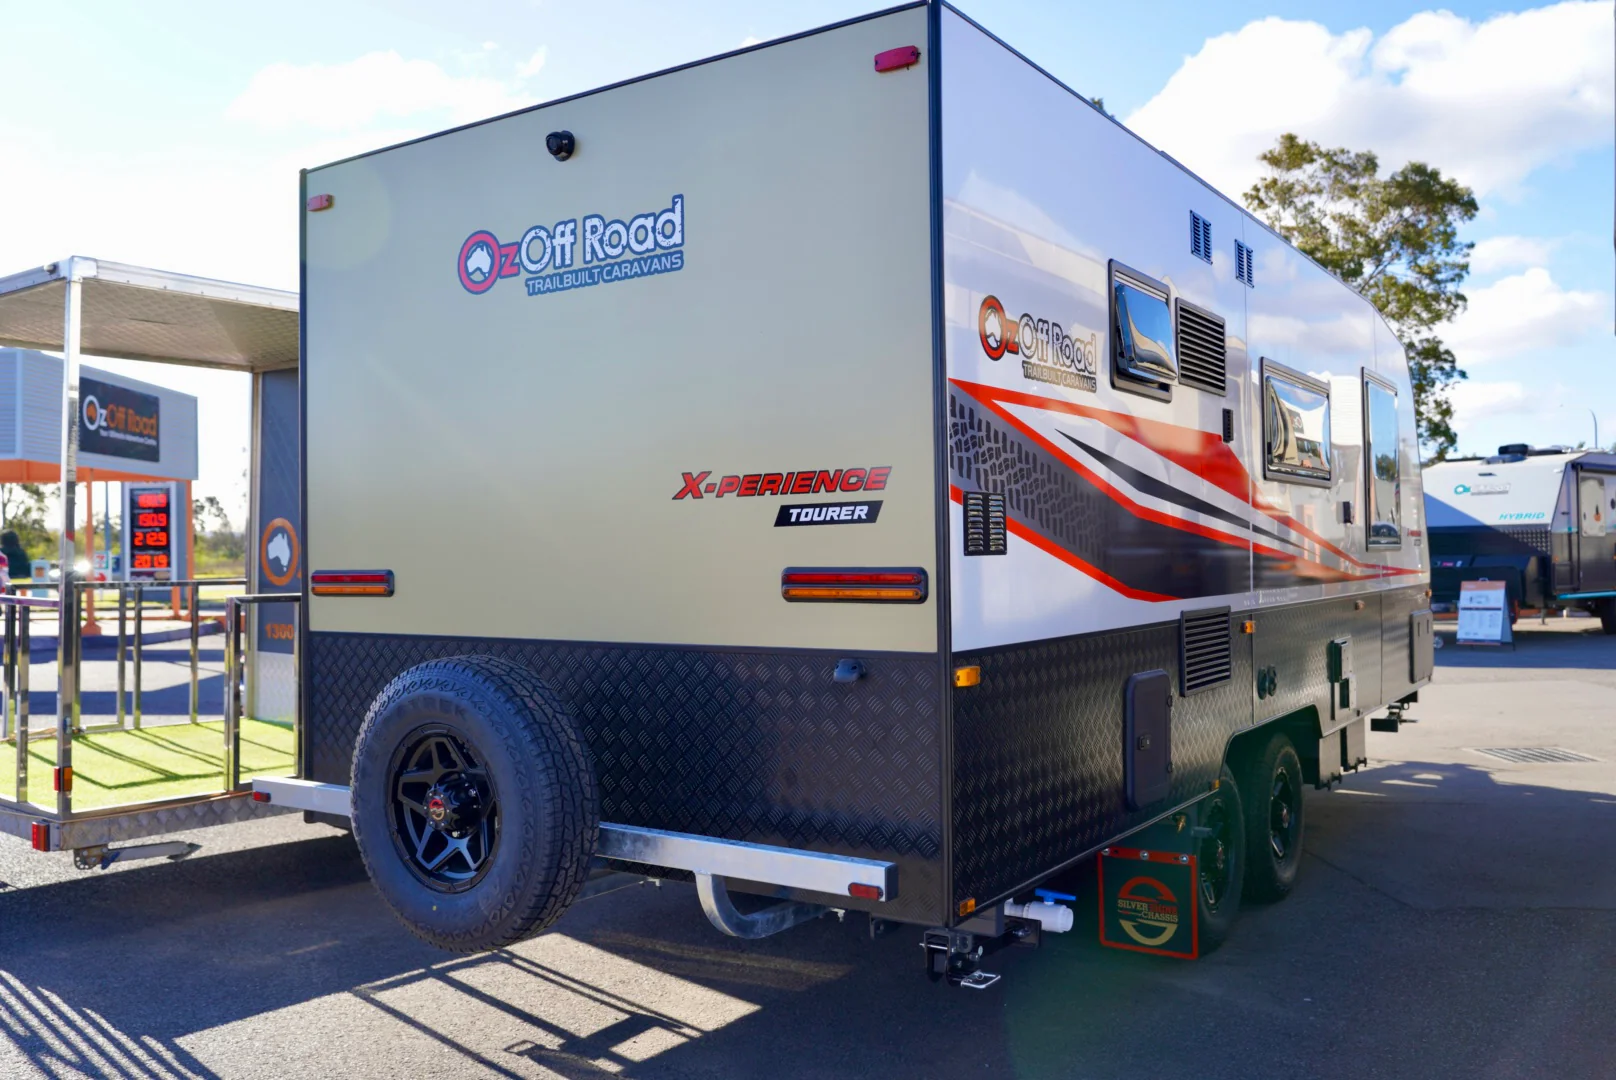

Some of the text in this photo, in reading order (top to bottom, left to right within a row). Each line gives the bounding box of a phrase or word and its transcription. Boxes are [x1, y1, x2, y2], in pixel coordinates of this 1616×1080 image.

[582, 194, 685, 264] Road
[526, 252, 684, 296] TRAILBUILT CARAVANS
[1052, 322, 1097, 375] Road
[1022, 362, 1097, 393] TRAILBUILT CARAVANS
[671, 466, 893, 501] X-PERIENCE
[789, 504, 870, 523] TOURER
[1499, 511, 1546, 521] HYBRID
[1117, 899, 1148, 911] SILVER
[1141, 911, 1178, 923] CHASSIS
